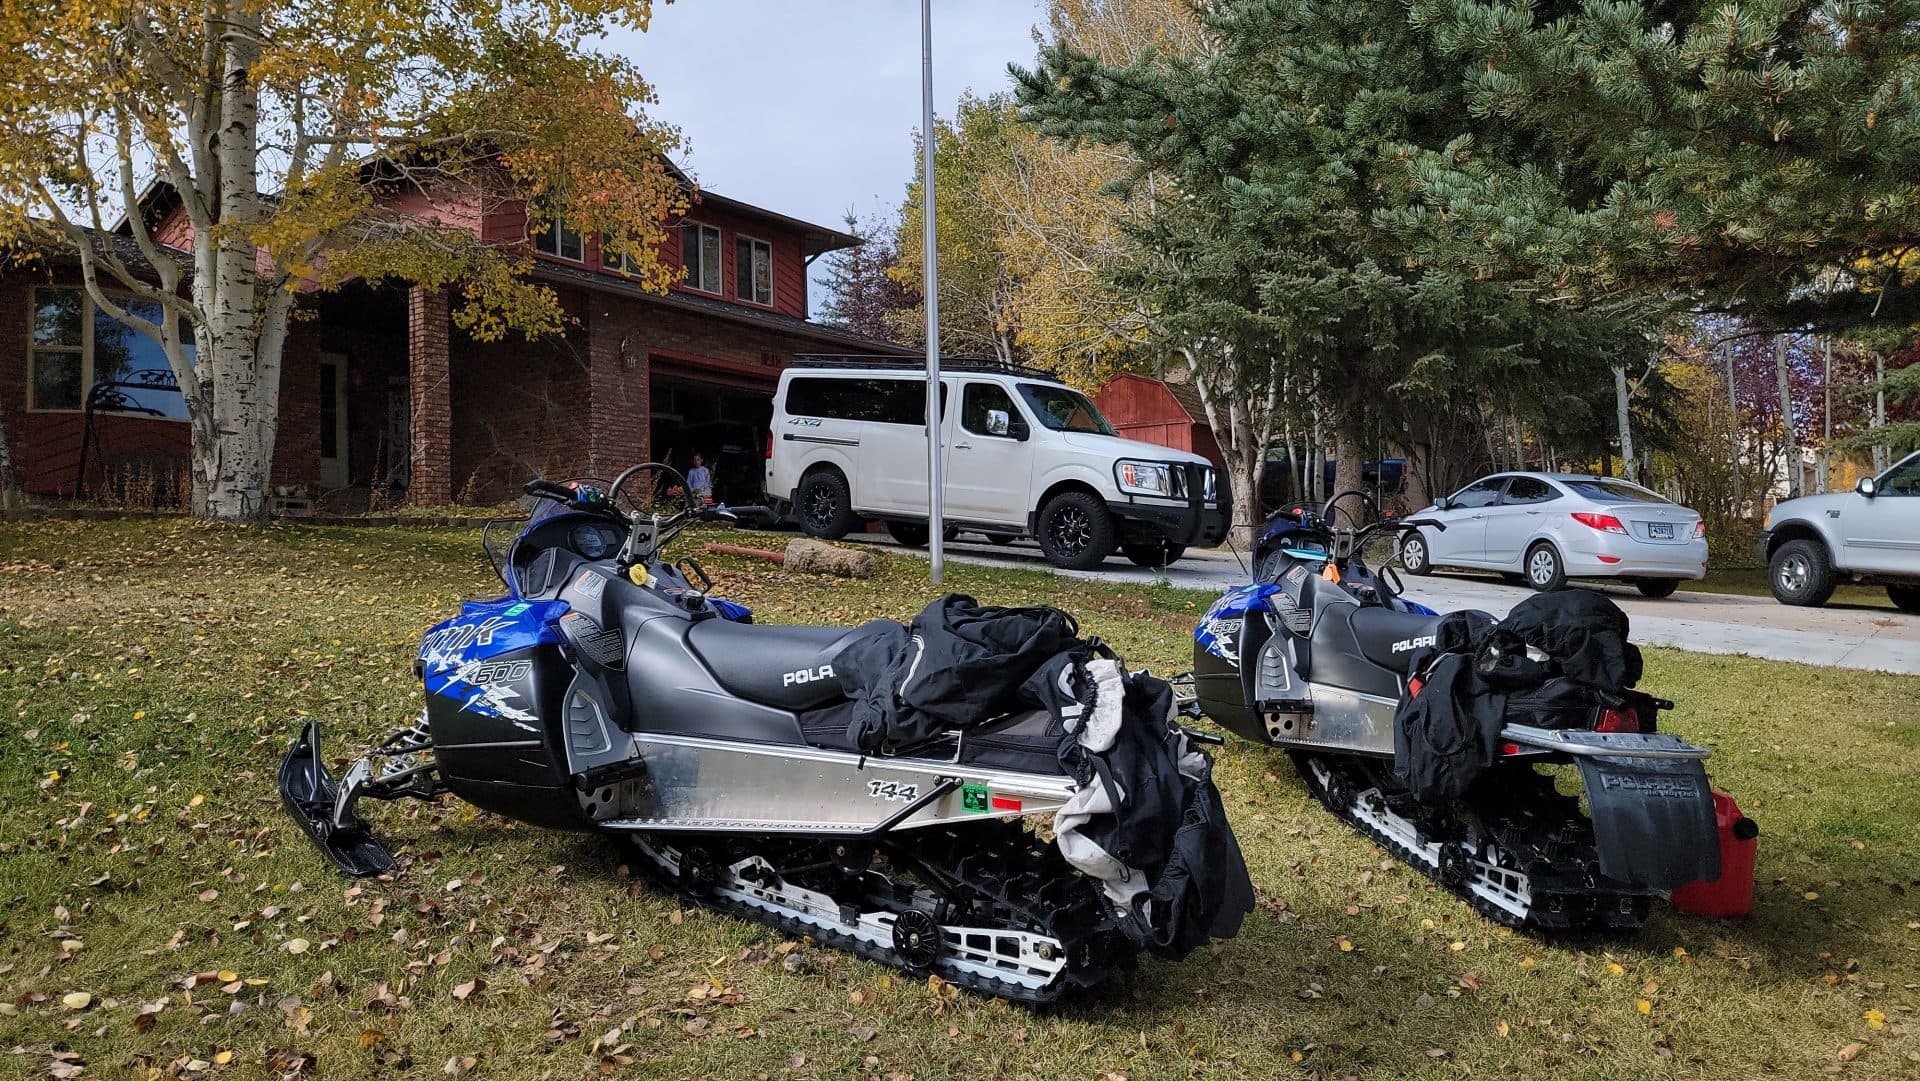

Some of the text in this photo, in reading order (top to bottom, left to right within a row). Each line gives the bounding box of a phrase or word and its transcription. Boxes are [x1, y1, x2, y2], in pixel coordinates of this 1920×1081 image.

[474, 660, 532, 685] 600
[783, 664, 836, 687] POLA
[868, 780, 917, 801] 144
[1601, 774, 1696, 791] POLARIS
